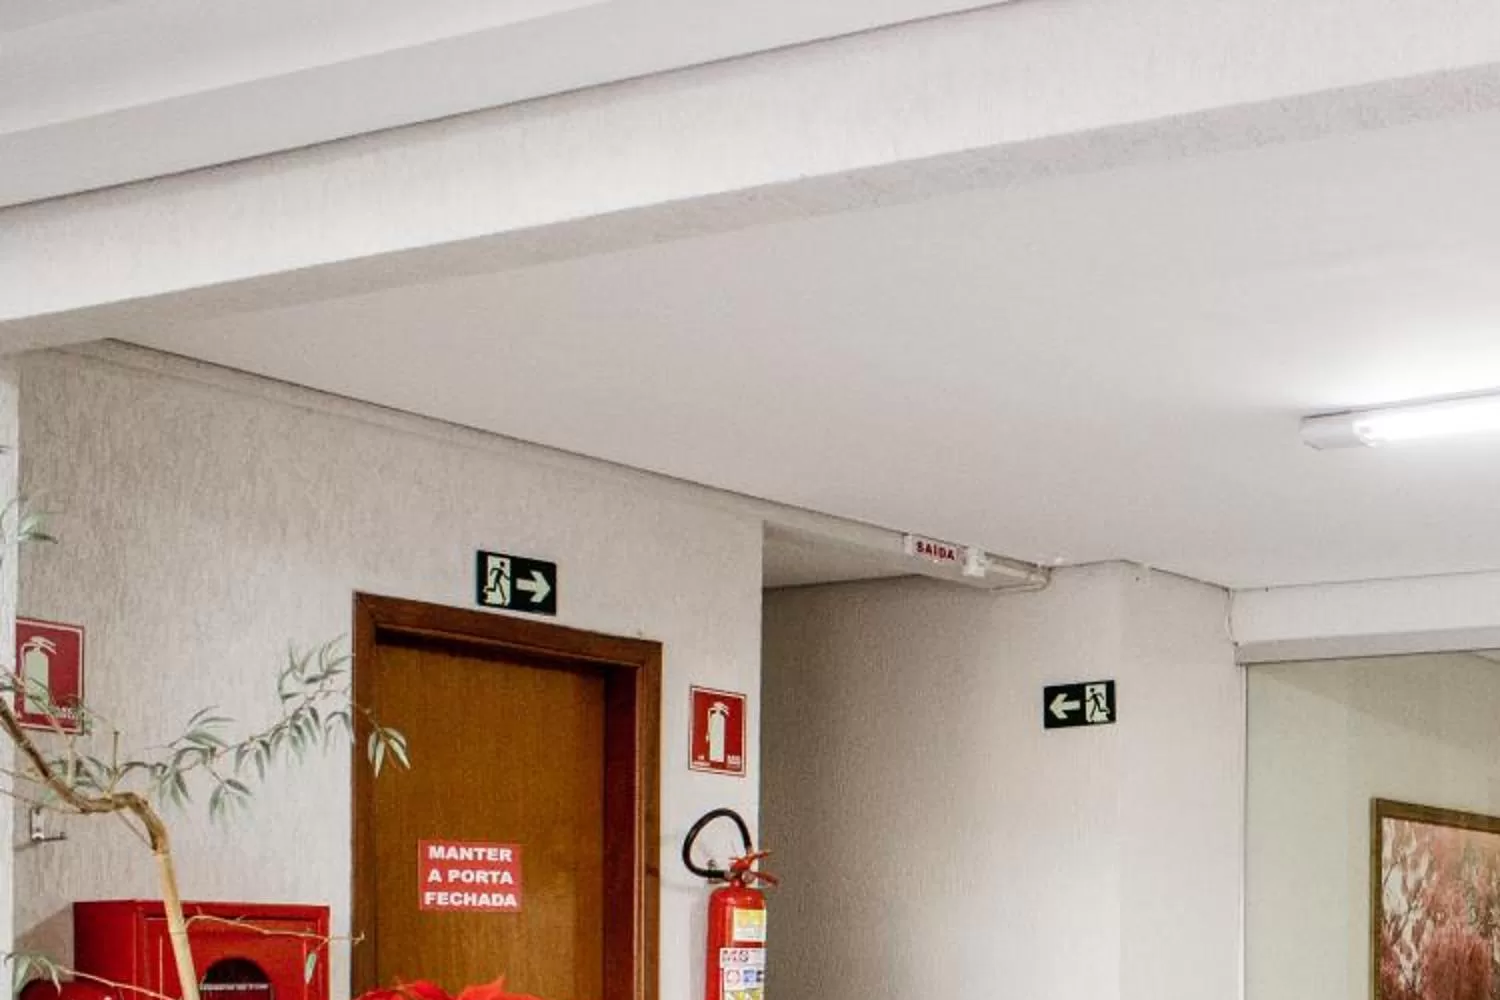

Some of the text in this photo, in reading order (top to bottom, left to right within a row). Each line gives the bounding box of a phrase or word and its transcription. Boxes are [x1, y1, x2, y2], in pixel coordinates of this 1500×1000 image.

[427, 845, 513, 863] MANTER
[427, 868, 514, 885] A PORTA
[424, 890, 518, 908] FECHADA
